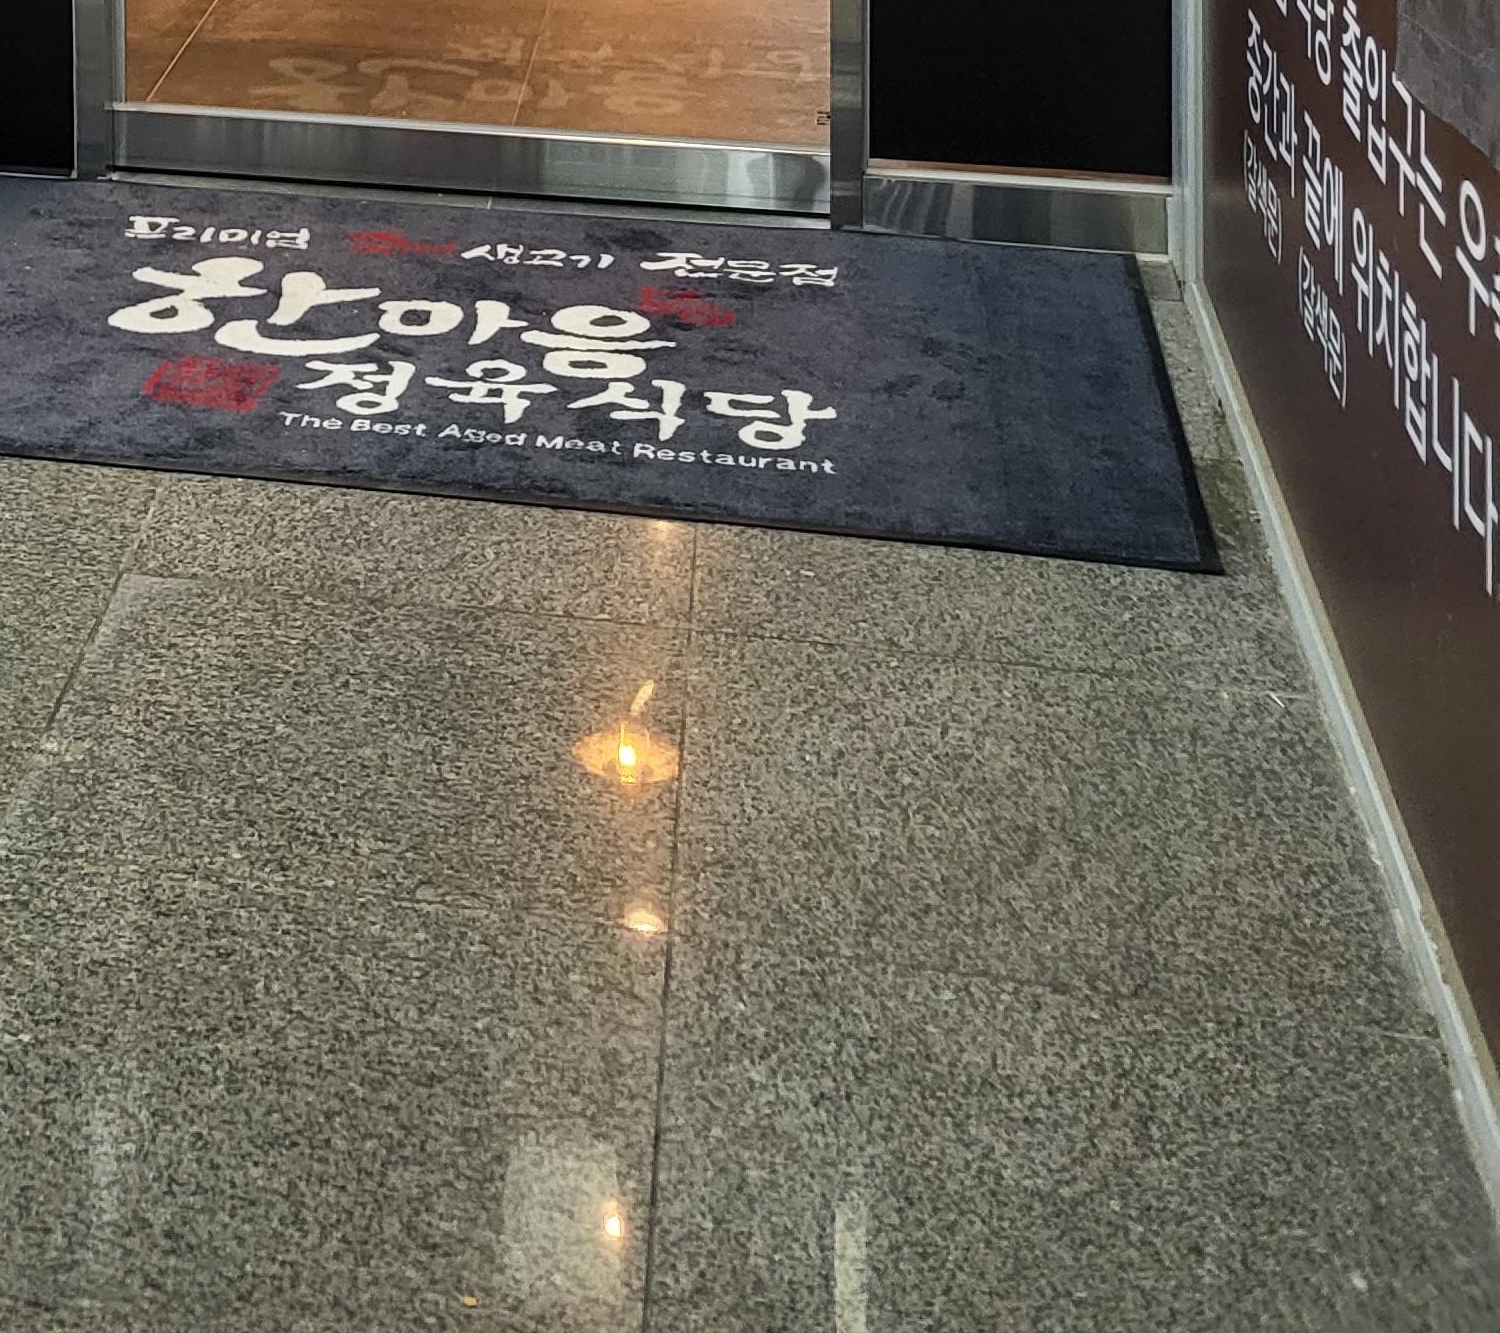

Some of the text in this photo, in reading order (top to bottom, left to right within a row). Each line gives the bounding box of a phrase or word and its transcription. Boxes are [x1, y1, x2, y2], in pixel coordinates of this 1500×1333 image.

[123, 214, 841, 288] 프리미엄 생고기 전문점
[1243, 129, 1282, 265] (갈색문)
[1456, 179, 1500, 343] 우
[107, 256, 677, 379] 한마음
[1247, 8, 1499, 597] 중간과 끝에 위치합니다
[1298, 245, 1346, 410] (갈색문)
[277, 412, 837, 476] The Best Aged Meat Restaurant
[297, 357, 839, 451] 정육식당
